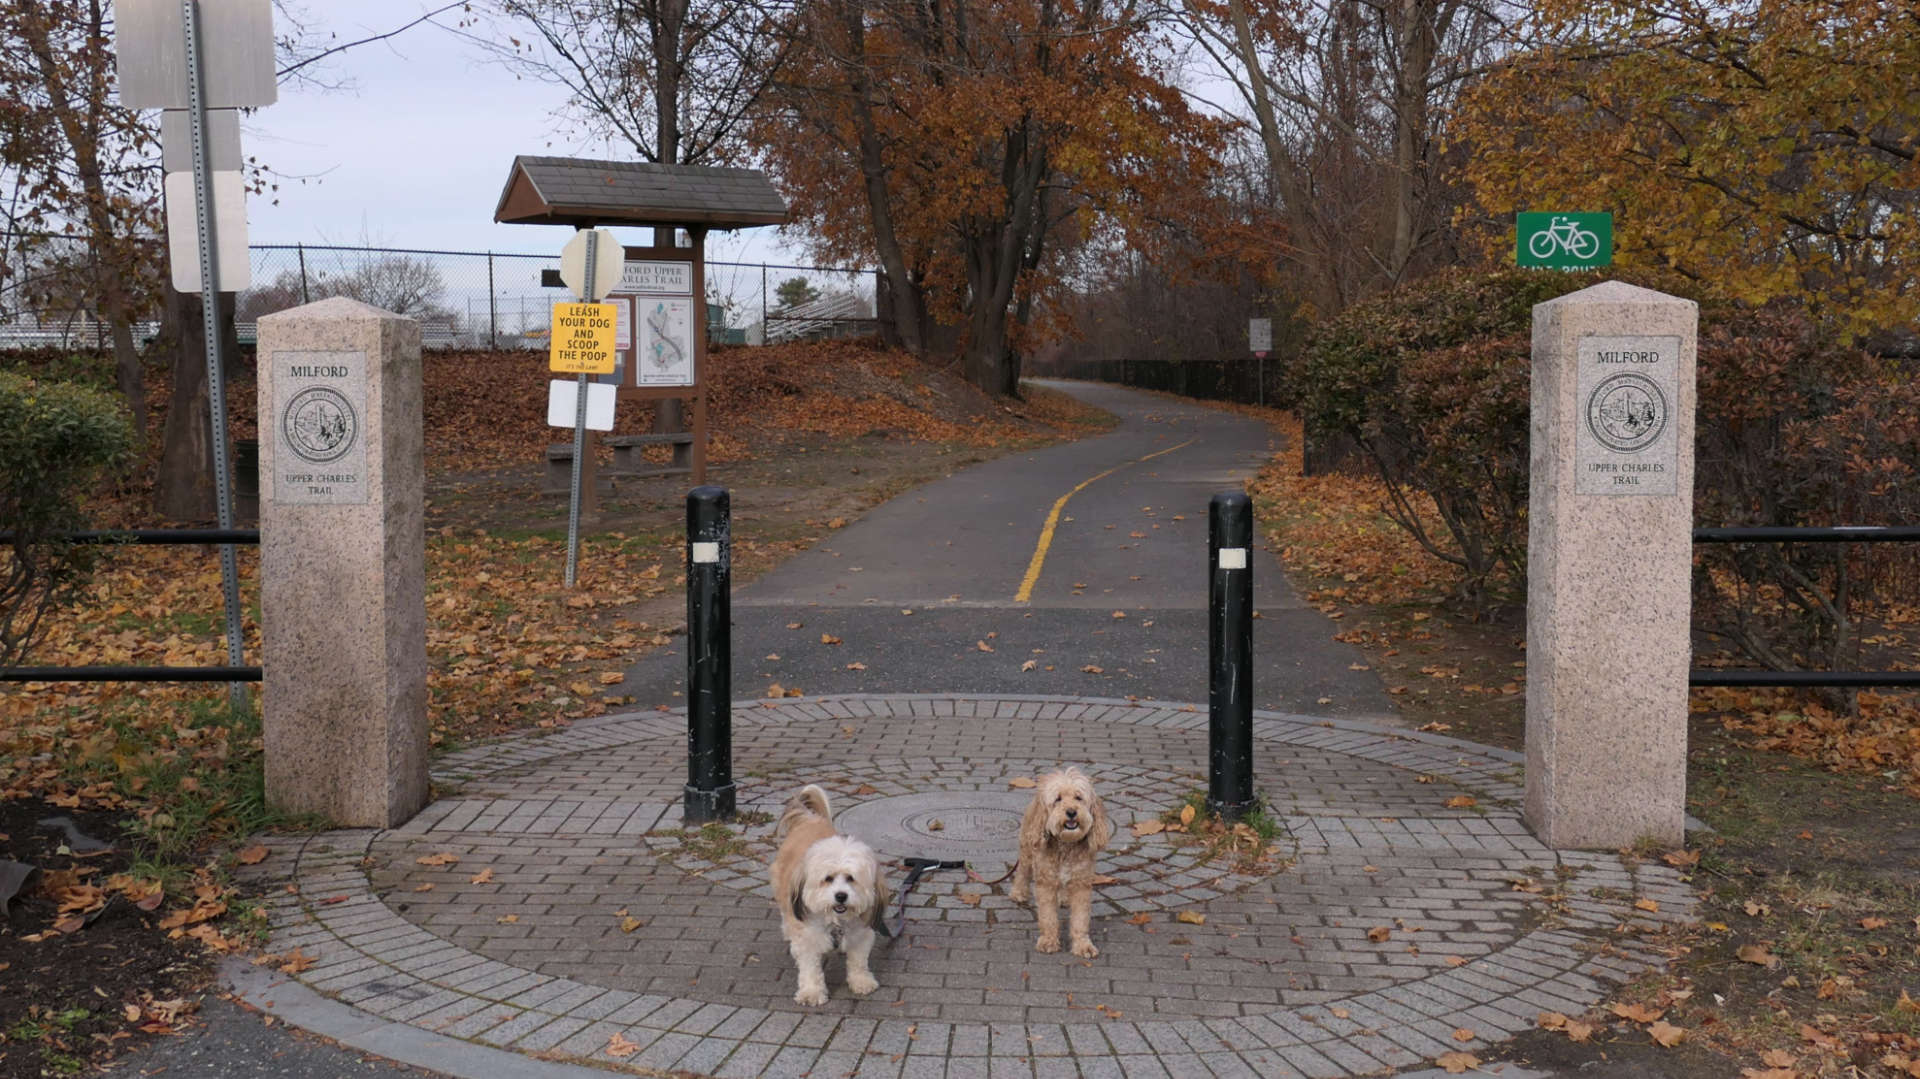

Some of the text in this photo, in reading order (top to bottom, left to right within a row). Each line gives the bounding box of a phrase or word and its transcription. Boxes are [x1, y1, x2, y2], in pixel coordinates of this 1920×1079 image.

[655, 276, 682, 285] TRAIL
[569, 307, 600, 317] LEASH
[560, 317, 610, 328] YOUR DOG
[574, 330, 594, 339] AND
[567, 340, 599, 349] SCOOP
[559, 350, 607, 361] THE POOP
[1597, 352, 1660, 364] MILFORD
[291, 366, 348, 377] MILFORD
[1588, 463, 1665, 473] UPPER CHARLES
[286, 474, 357, 483] UPPER CHARLES
[1612, 475, 1641, 485] TRAIL
[308, 486, 335, 496] TRAIL
